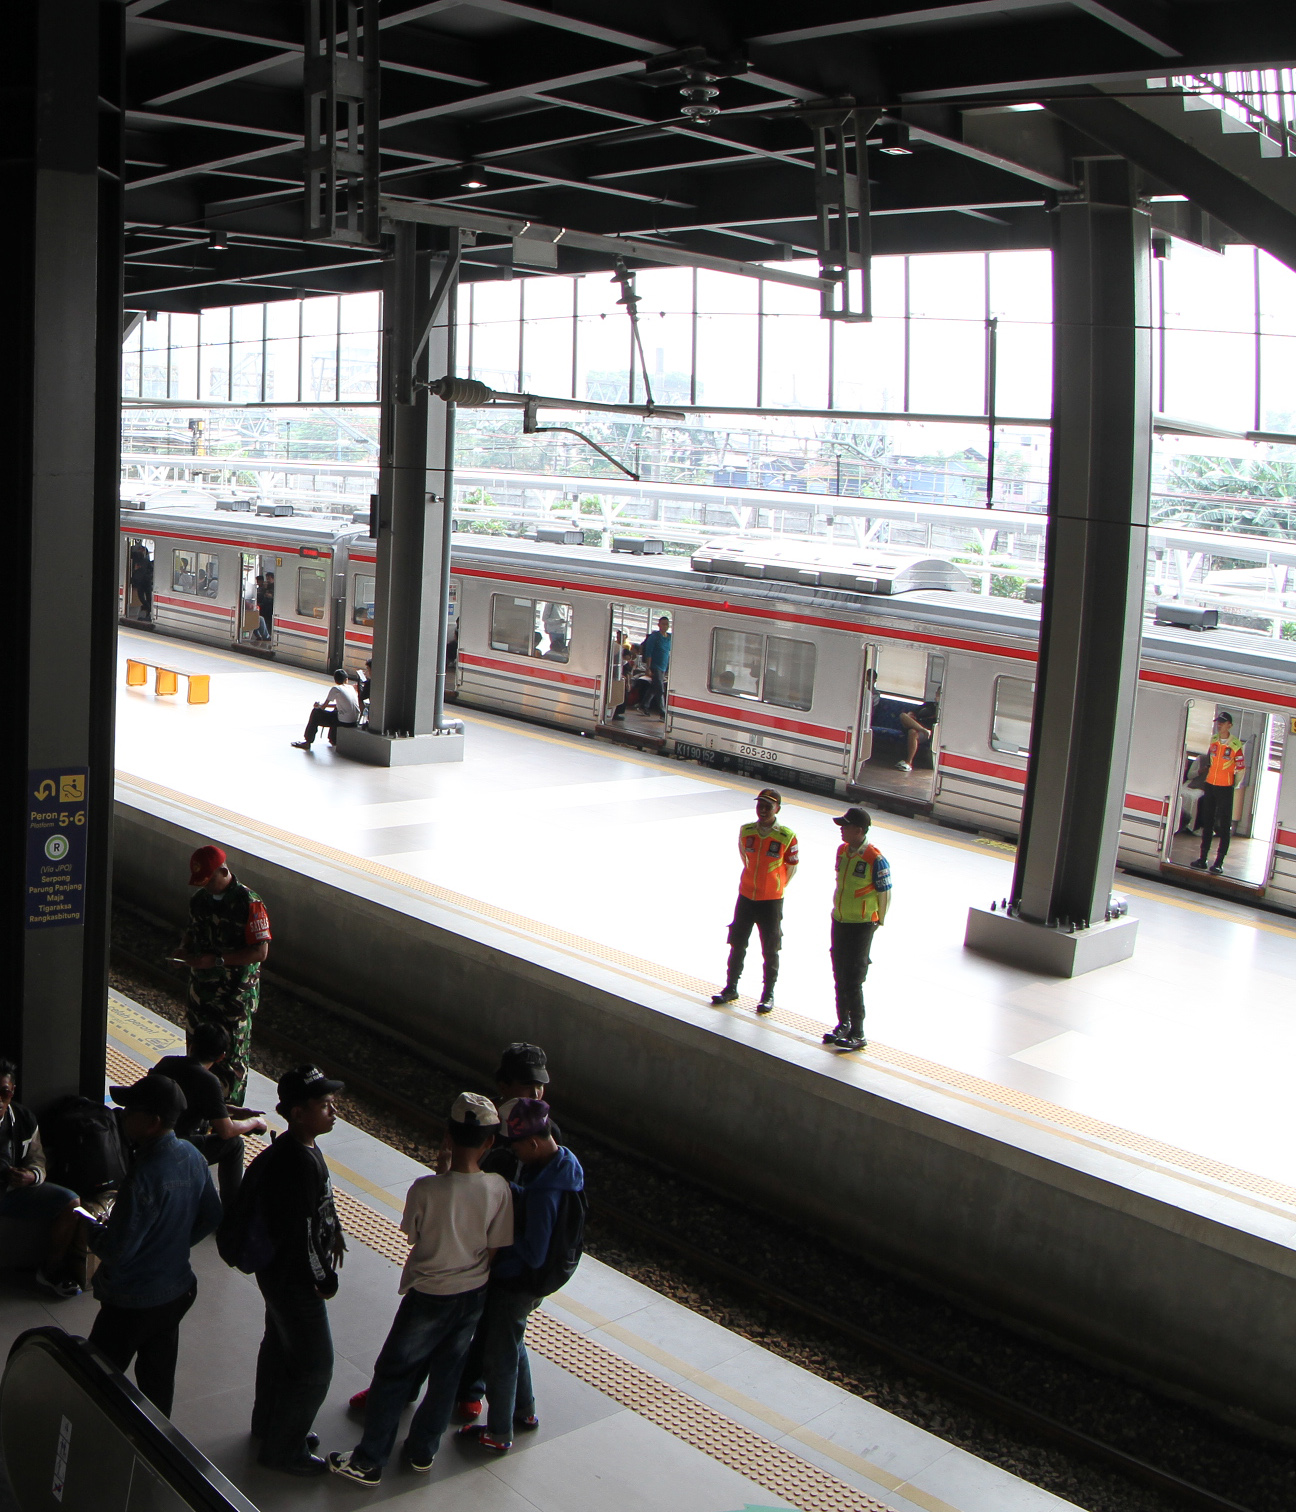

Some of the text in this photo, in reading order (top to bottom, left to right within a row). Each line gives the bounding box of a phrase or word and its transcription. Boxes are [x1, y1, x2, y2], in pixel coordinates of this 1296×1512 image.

[702, 750, 715, 762] 152
[740, 746, 777, 761] 205-230
[30, 812, 58, 820] Peron
[54, 843, 60, 852] R
[38, 903, 72, 912] Tigaraksa
[30, 912, 80, 922] Rangkasbitung
